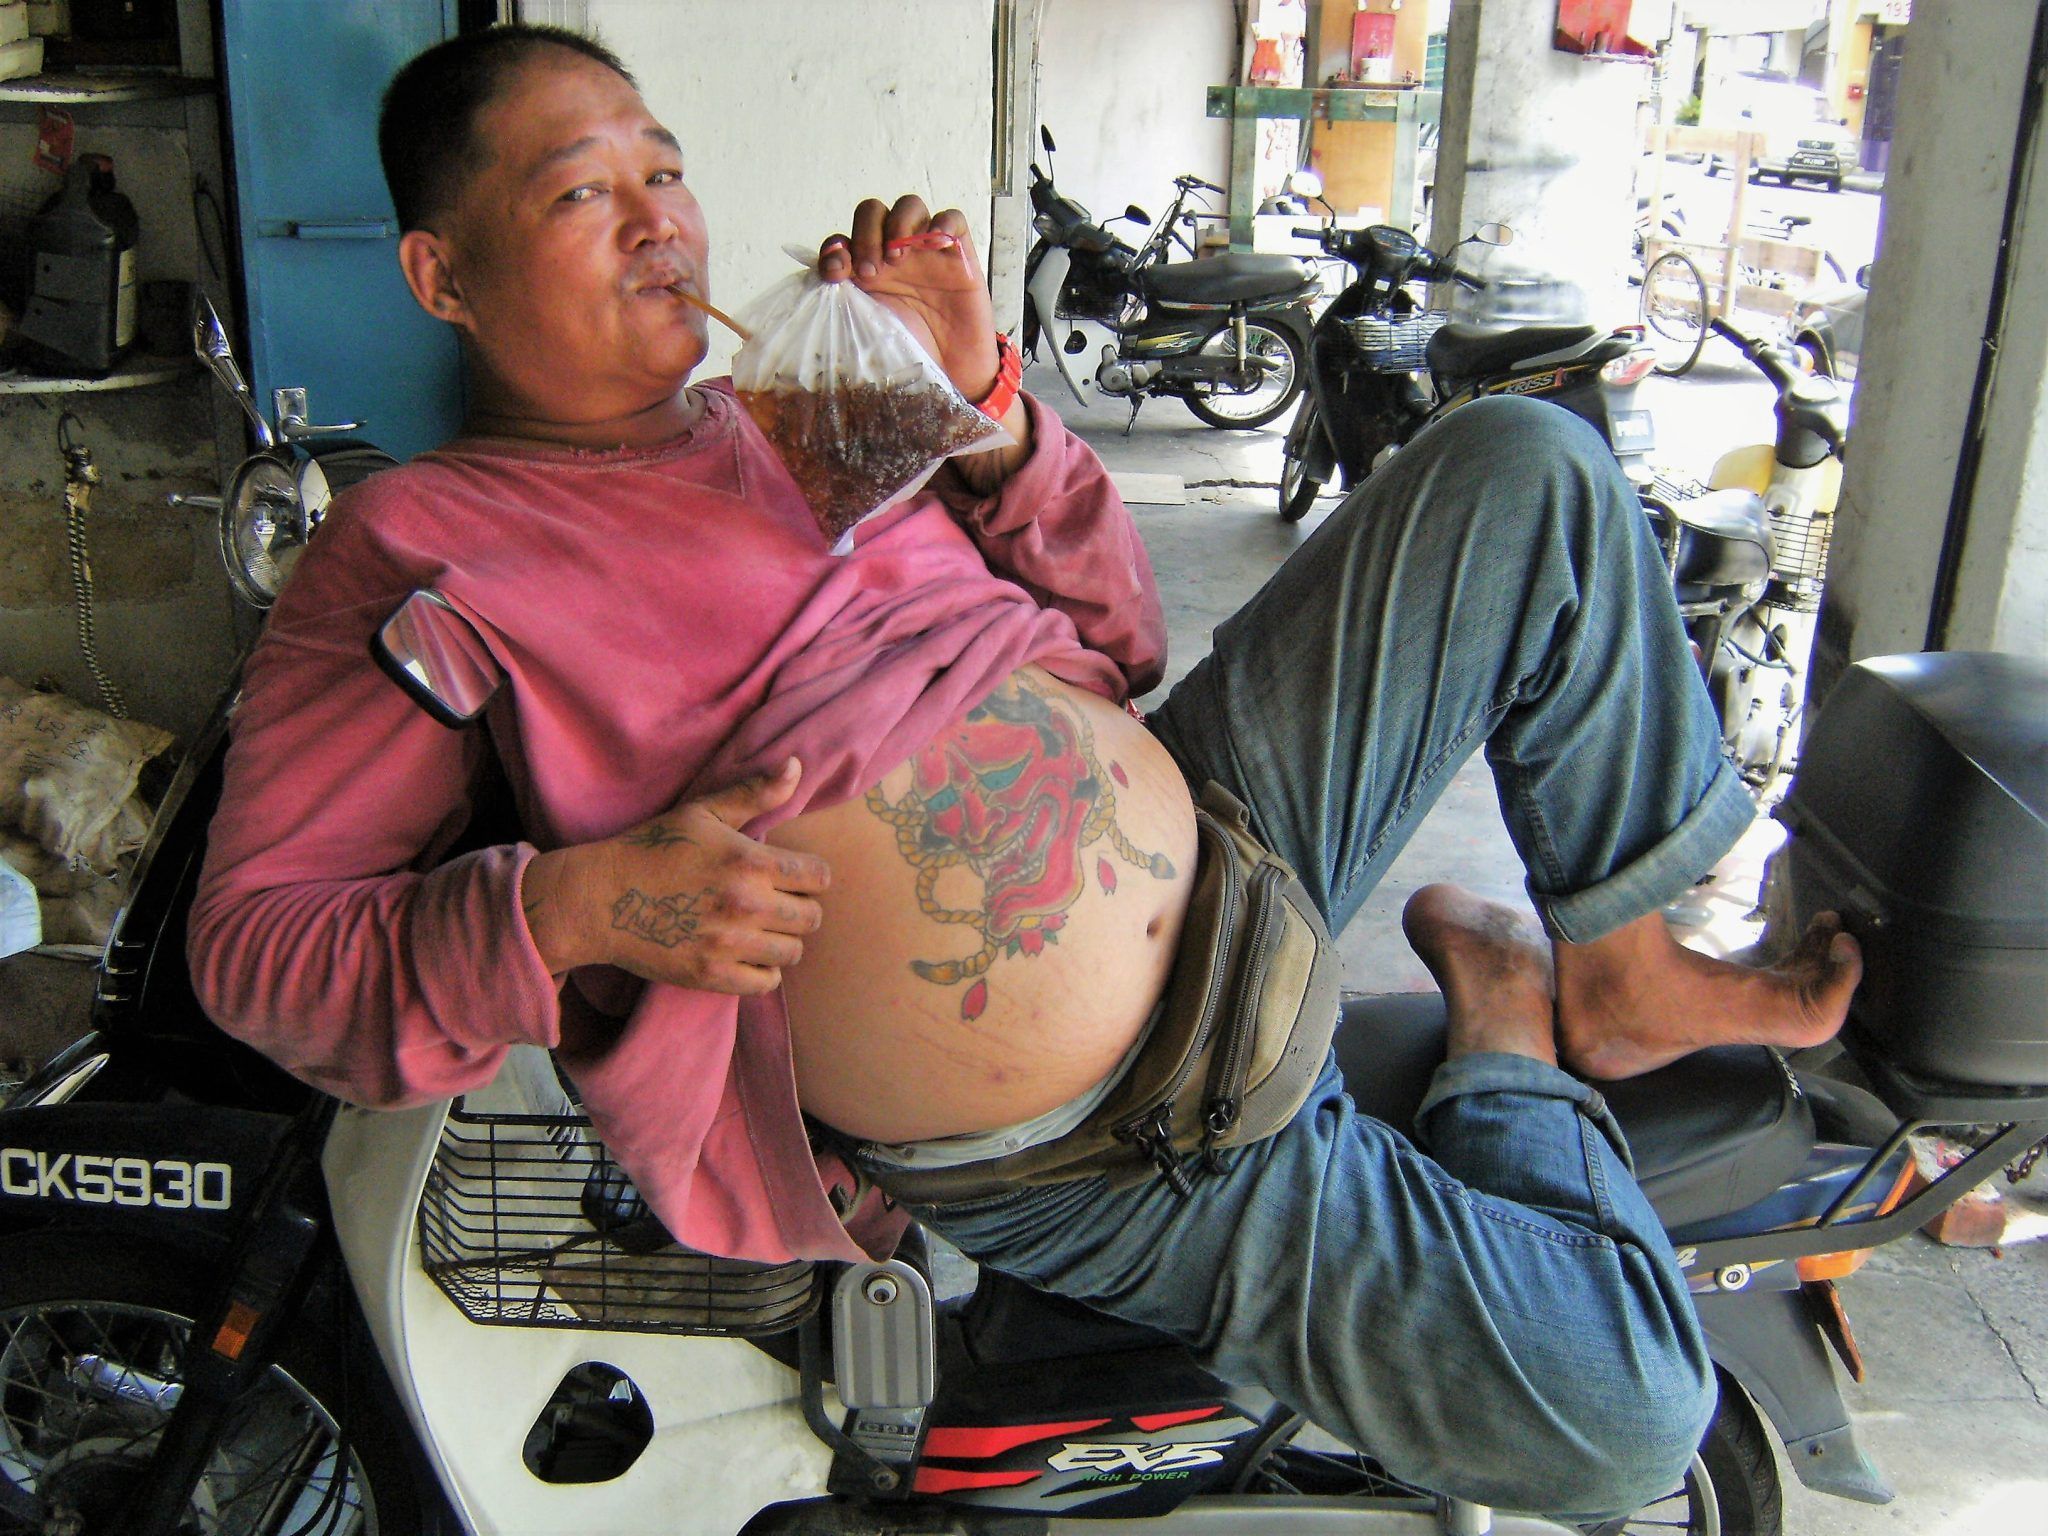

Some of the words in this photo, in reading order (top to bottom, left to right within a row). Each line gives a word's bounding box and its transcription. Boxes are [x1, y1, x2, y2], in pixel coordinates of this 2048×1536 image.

[1504, 375, 1554, 395] KRISS
[0, 1148, 232, 1210] CK5930
[1047, 1440, 1236, 1472] EX5
[1082, 1472, 1121, 1482] HIGH
[1129, 1471, 1190, 1481] POWER
